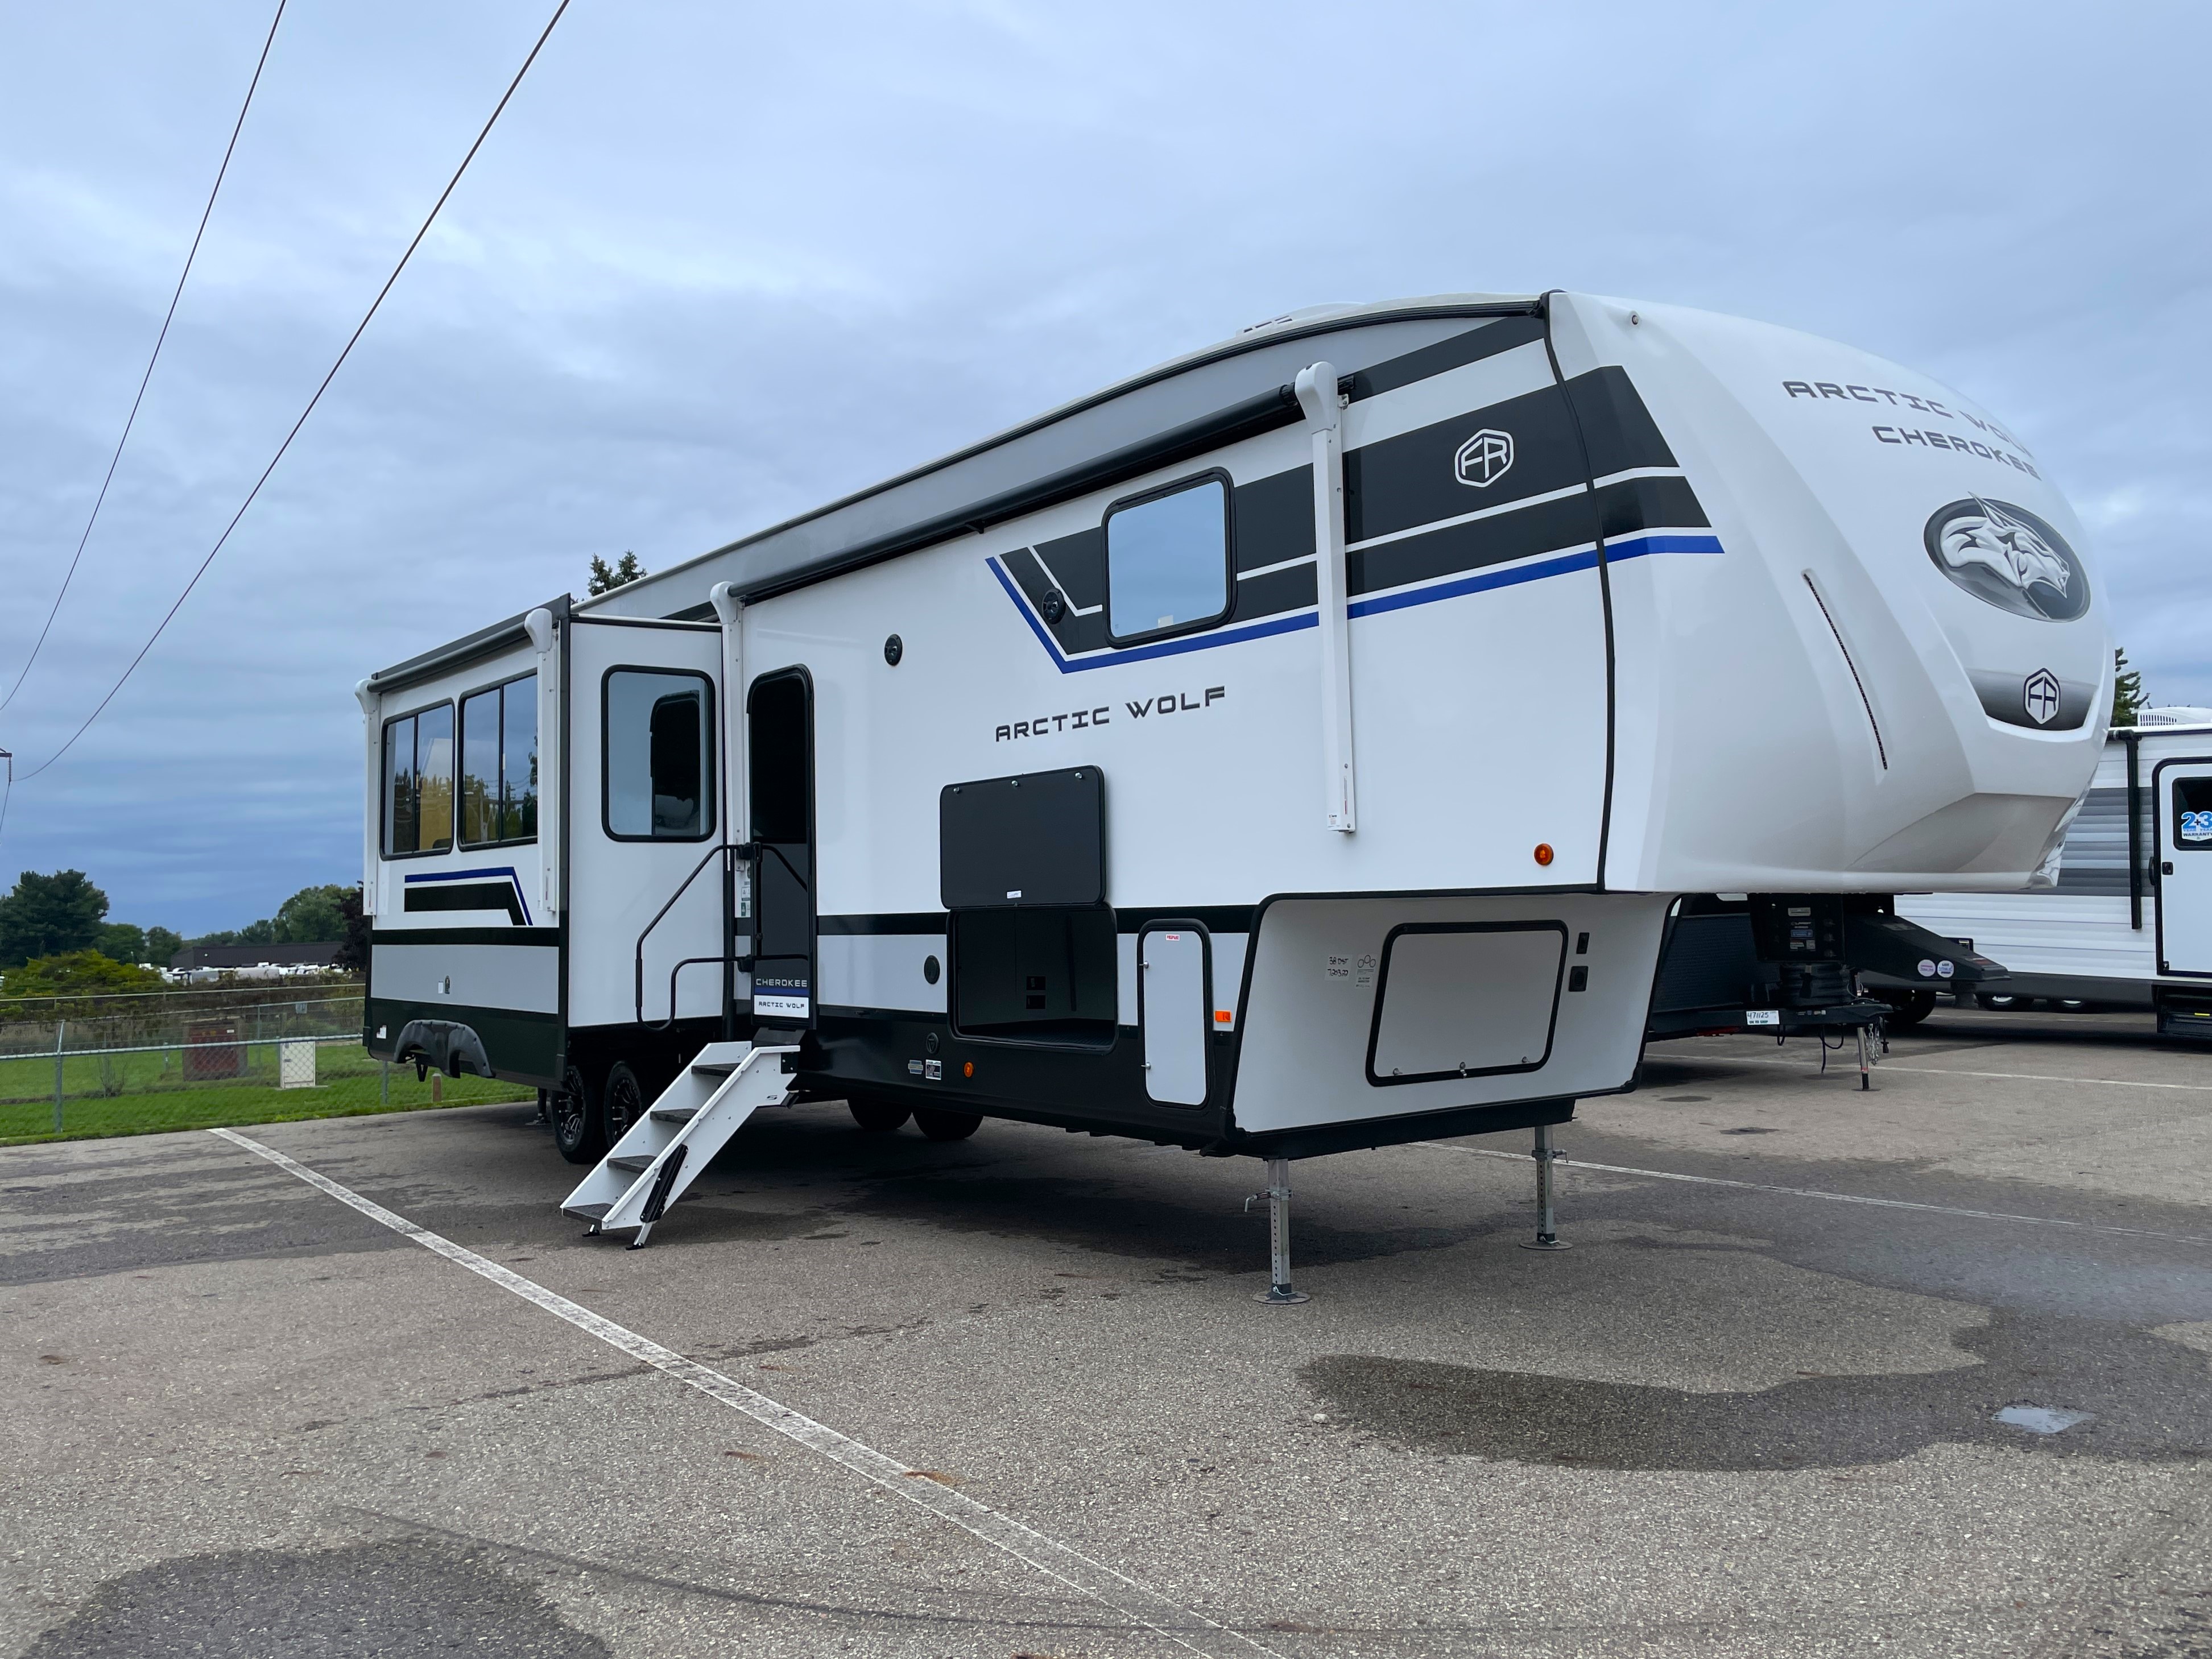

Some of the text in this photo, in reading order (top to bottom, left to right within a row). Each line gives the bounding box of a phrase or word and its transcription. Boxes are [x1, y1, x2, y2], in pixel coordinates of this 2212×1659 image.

[1782, 380, 1954, 419] ARCTIC
[1871, 425, 2042, 481] CHEROKEE
[995, 685, 1225, 742] ARCTIC WOLF
[755, 978, 808, 987] CHEROKEE
